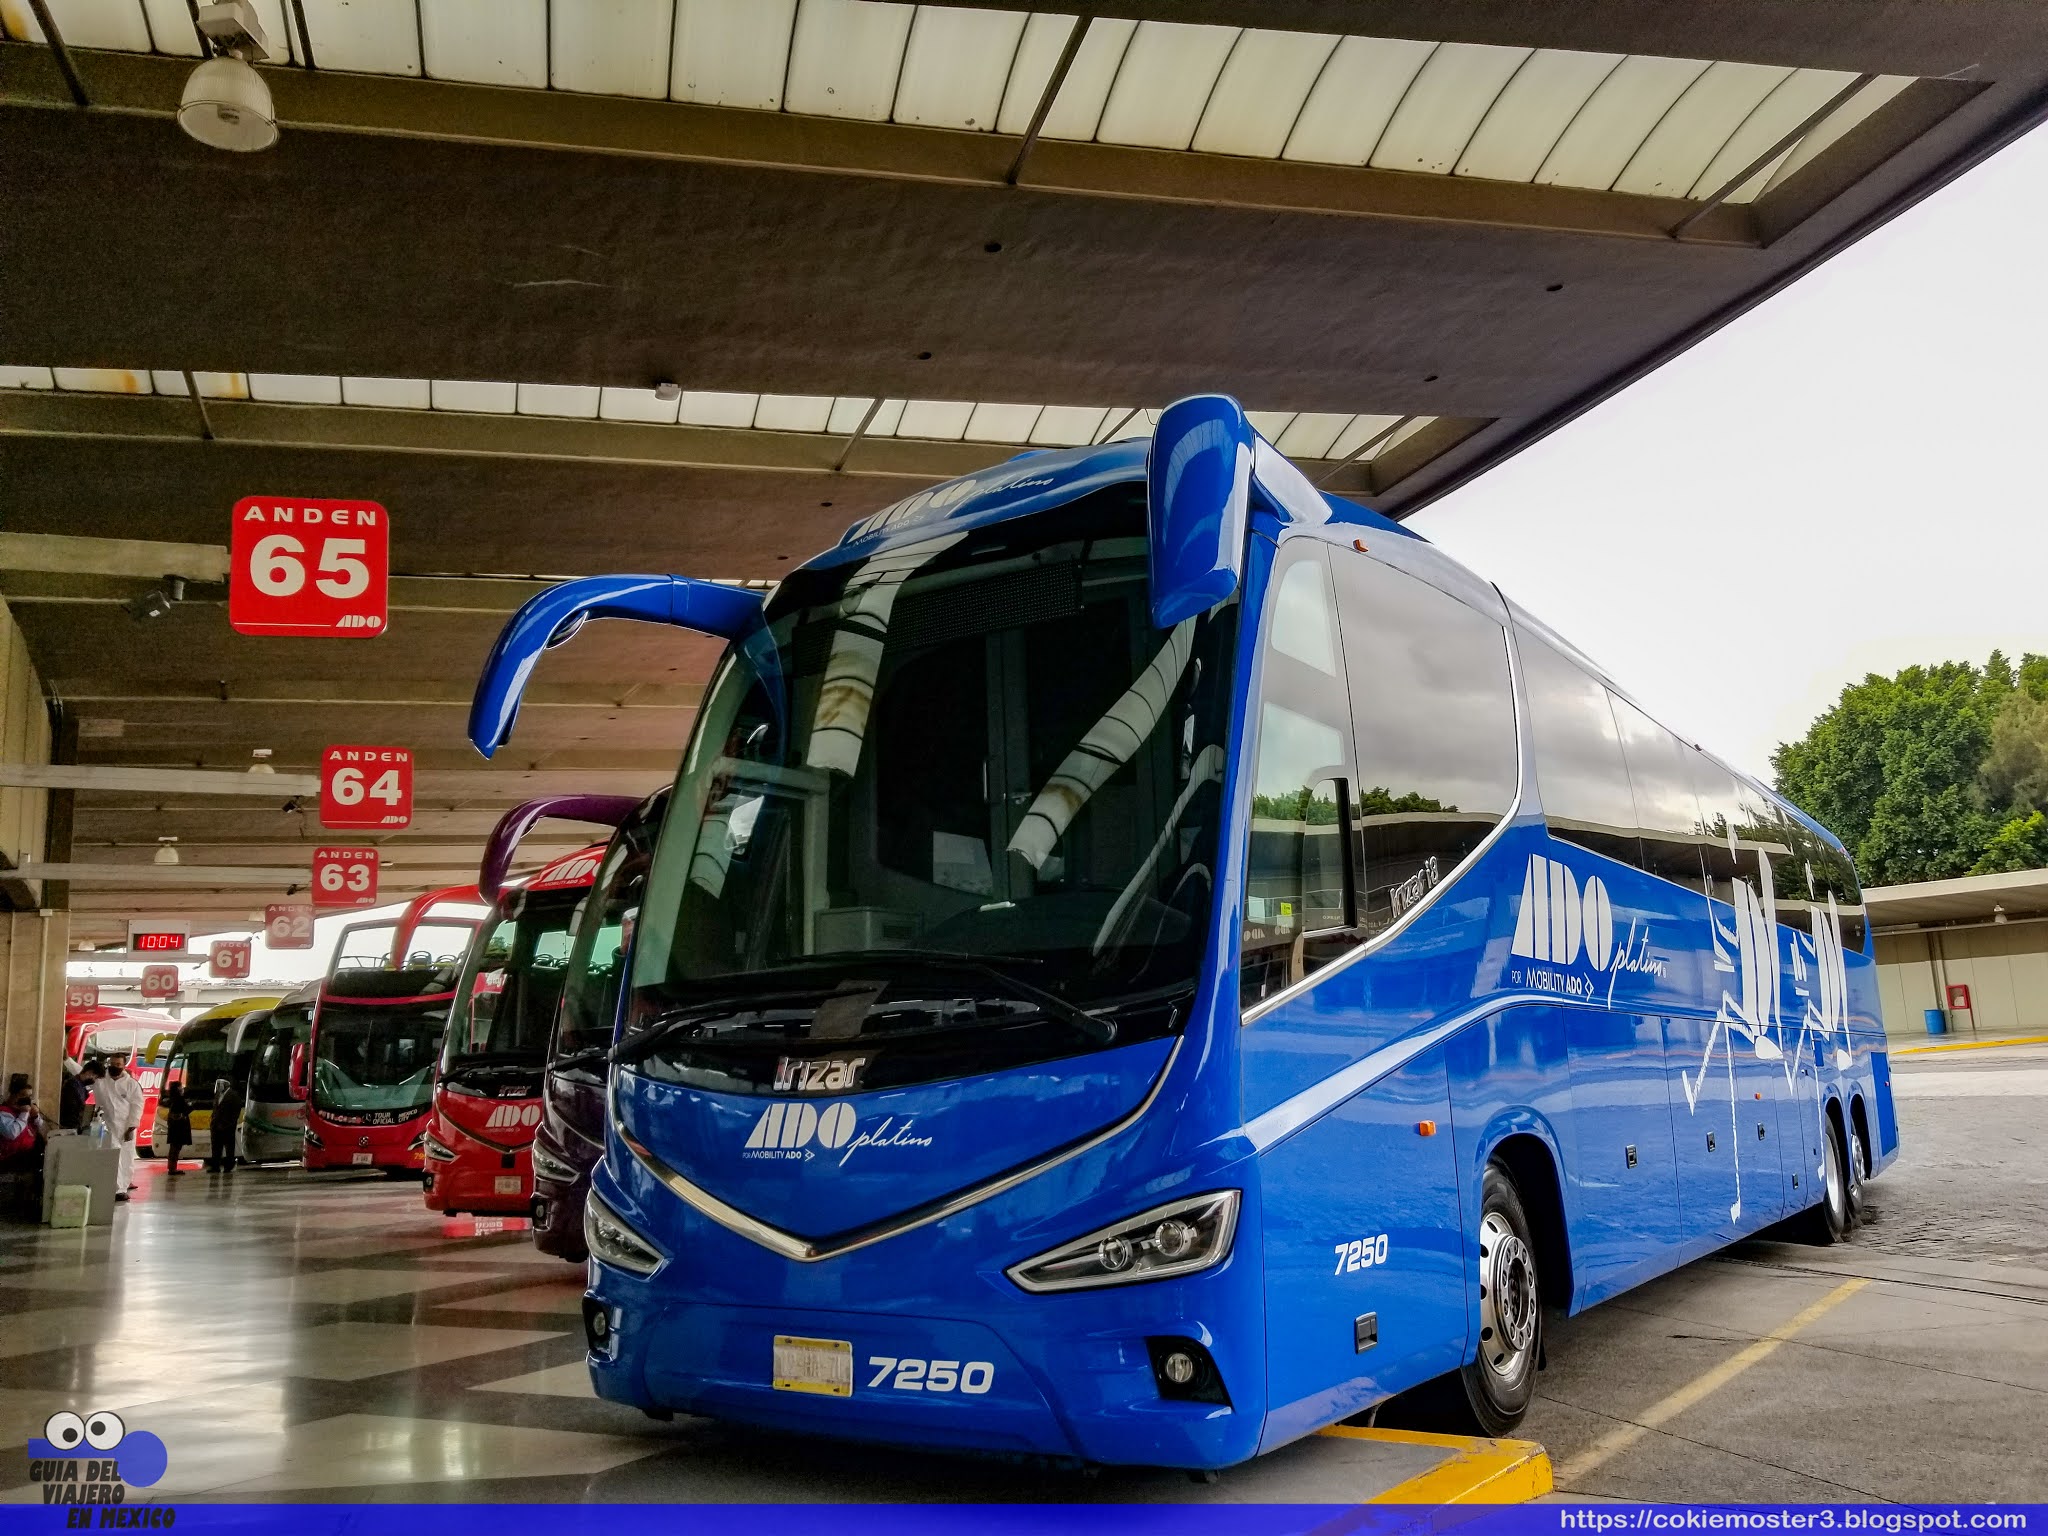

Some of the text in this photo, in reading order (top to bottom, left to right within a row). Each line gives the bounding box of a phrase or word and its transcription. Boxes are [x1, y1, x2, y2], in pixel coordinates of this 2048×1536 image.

[243, 505, 377, 526] ANDEN
[847, 479, 977, 543] ADO
[250, 534, 370, 599] 65
[335, 614, 382, 628] ADO
[329, 750, 408, 762] ANDEN
[331, 767, 402, 806] 64
[380, 815, 408, 824] ADO
[318, 851, 375, 859] ANDEN
[320, 863, 370, 892] 63
[1511, 853, 1613, 972] ADO
[271, 915, 310, 938] 62
[140, 935, 179, 949] 10:04
[216, 949, 246, 969] 61
[146, 974, 175, 990] 60
[1511, 966, 1583, 995] POR MOBILITY ADO
[70, 992, 96, 1007] 59
[772, 1056, 866, 1091] Irizar
[372, 1117, 395, 1125] OFICIAL
[485, 1104, 541, 1128] ADO
[744, 1102, 933, 1168] ADO platino
[750, 1150, 785, 1159] MOBILITY
[785, 1150, 802, 1159] ADO
[1334, 1233, 1388, 1276] 7250
[868, 1356, 995, 1394] 7250
